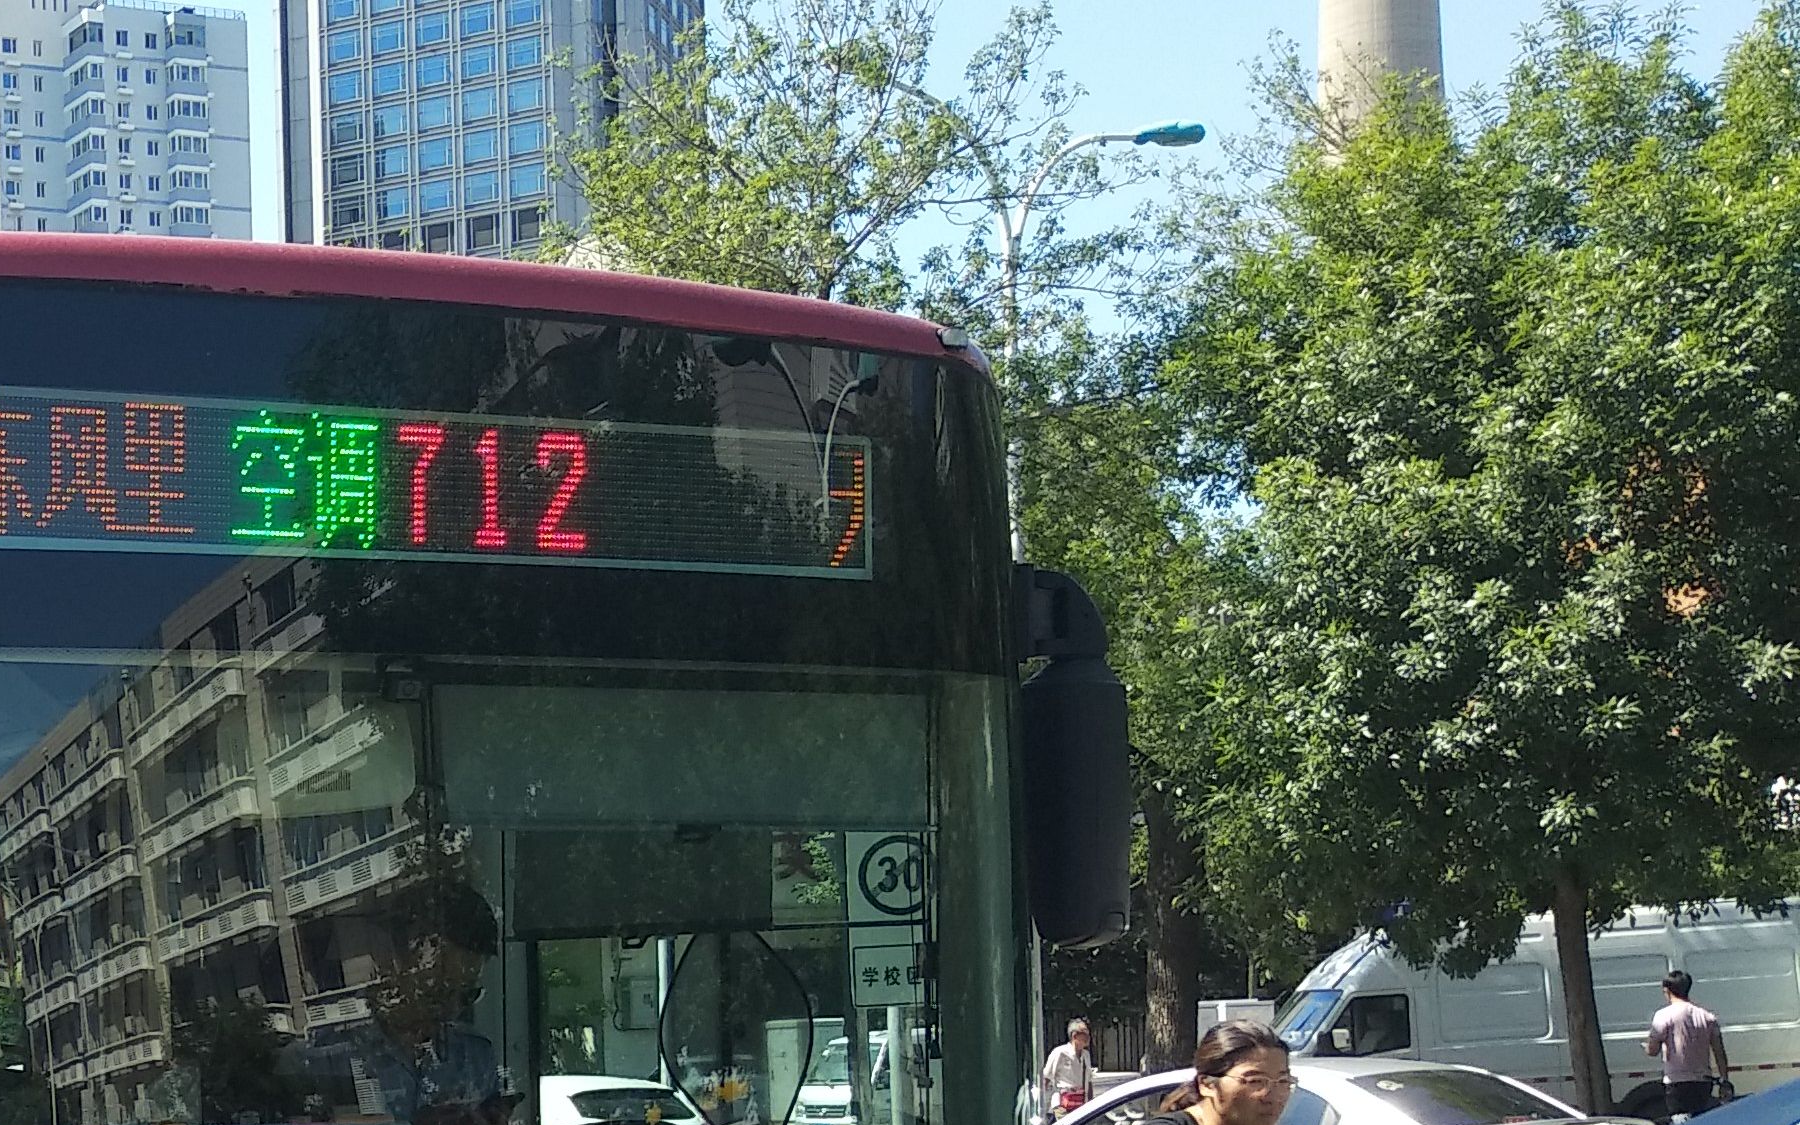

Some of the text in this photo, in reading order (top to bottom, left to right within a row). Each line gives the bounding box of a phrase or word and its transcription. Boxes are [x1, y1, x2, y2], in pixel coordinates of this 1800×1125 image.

[232, 409, 378, 548] 空调
[398, 422, 586, 550] 712
[877, 856, 922, 892] 30
